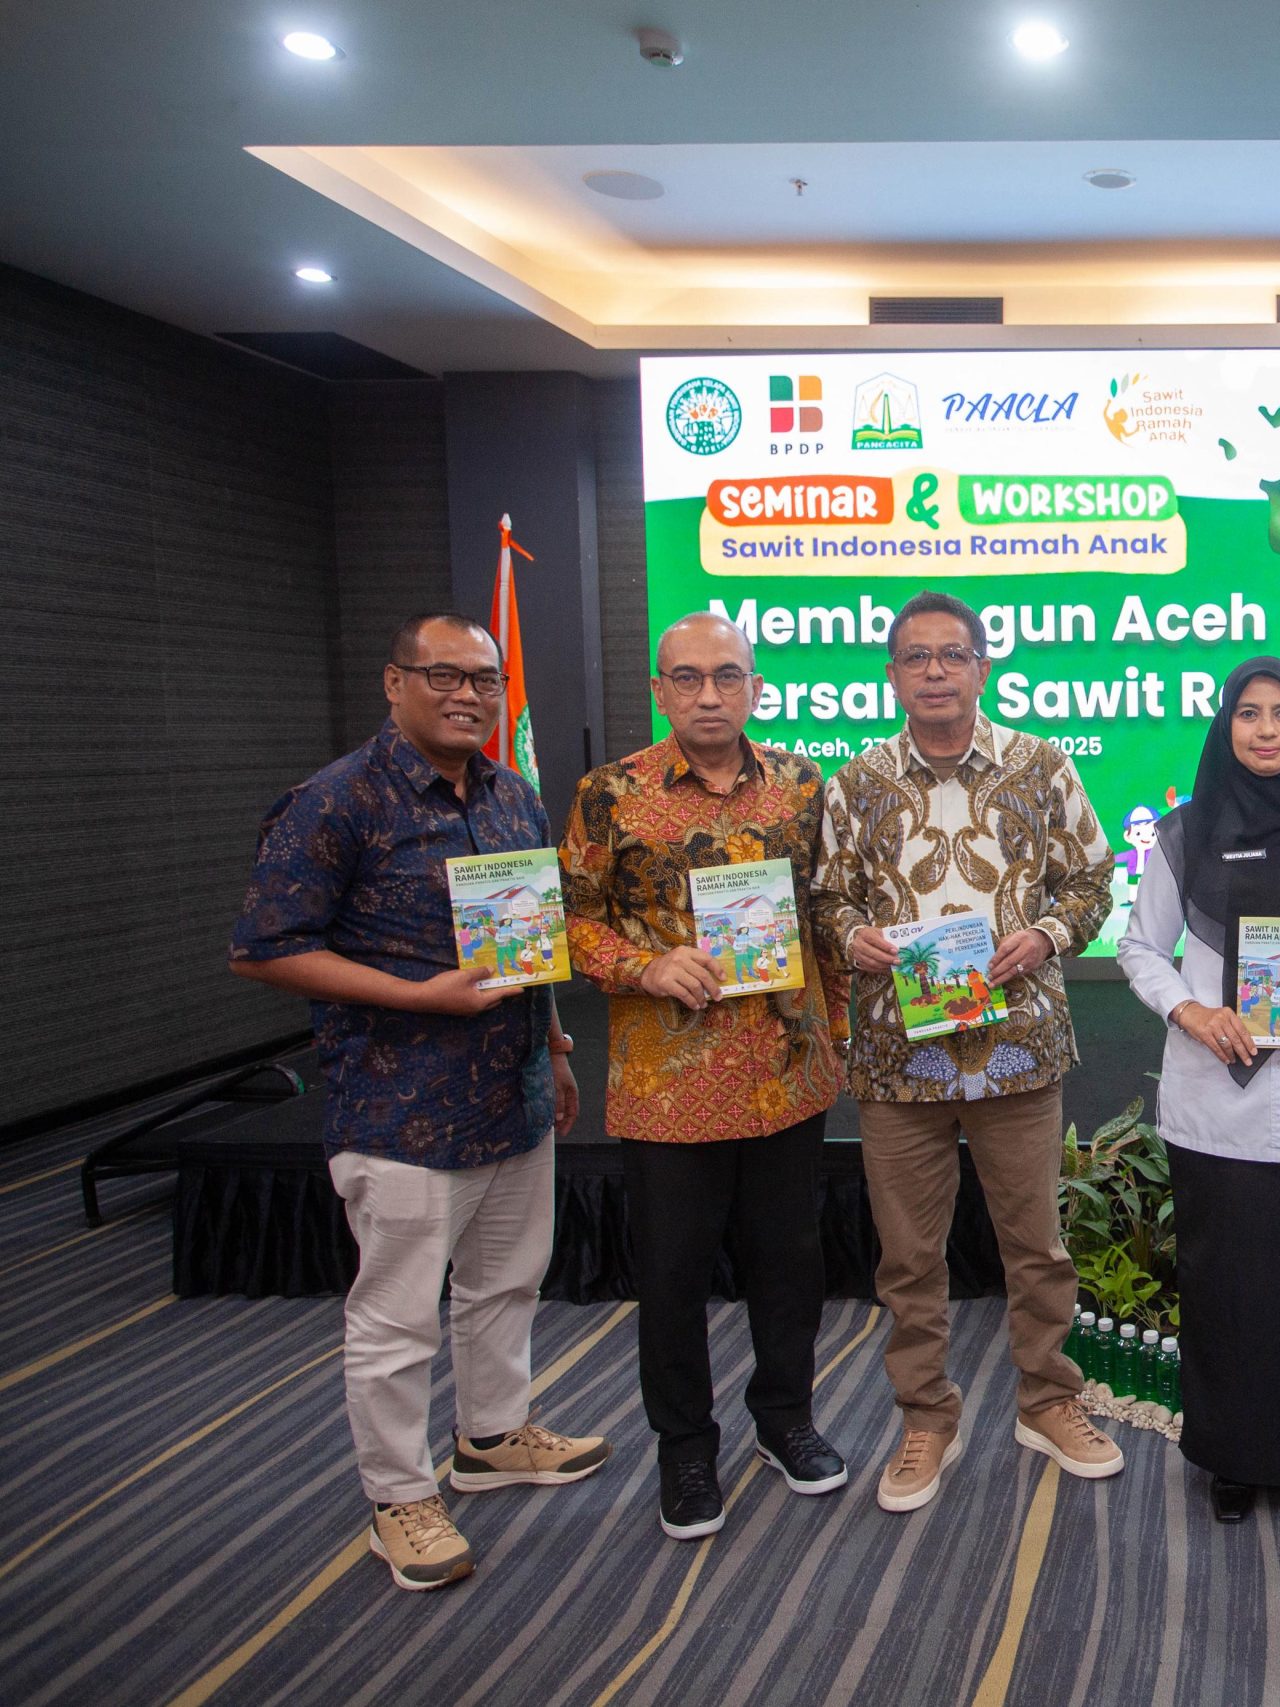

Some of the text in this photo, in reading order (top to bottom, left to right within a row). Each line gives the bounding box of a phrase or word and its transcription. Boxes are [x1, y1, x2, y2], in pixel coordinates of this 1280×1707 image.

[1142, 389, 1184, 403] Sawit
[942, 392, 1079, 423] PAACLA
[1130, 404, 1203, 417] Indonesia
[1137, 418, 1192, 432] Ramah
[1149, 430, 1187, 443] Anak
[770, 443, 824, 455] BPDP
[857, 441, 917, 449] PANCACITA
[906, 473, 940, 530] &
[972, 482, 1169, 518] WORKSHOP
[721, 533, 1168, 558] Sawit Indonesia Ramah Anak
[708, 592, 1266, 659] Membgun Aceh
[751, 681, 980, 721] ersa
[997, 665, 1165, 720] Sawit
[793, 737, 856, 760] Aceh,
[454, 859, 534, 875] SAWIT INDONESIA
[454, 872, 487, 882] RAMAH
[489, 869, 514, 879] ANAK
[695, 869, 768, 885] SAWIT INDONESIA
[696, 882, 726, 892] RAMAH
[727, 879, 750, 888] ANAK
[1245, 925, 1270, 933] SAWIT
[1245, 933, 1273, 941] RAMAH
